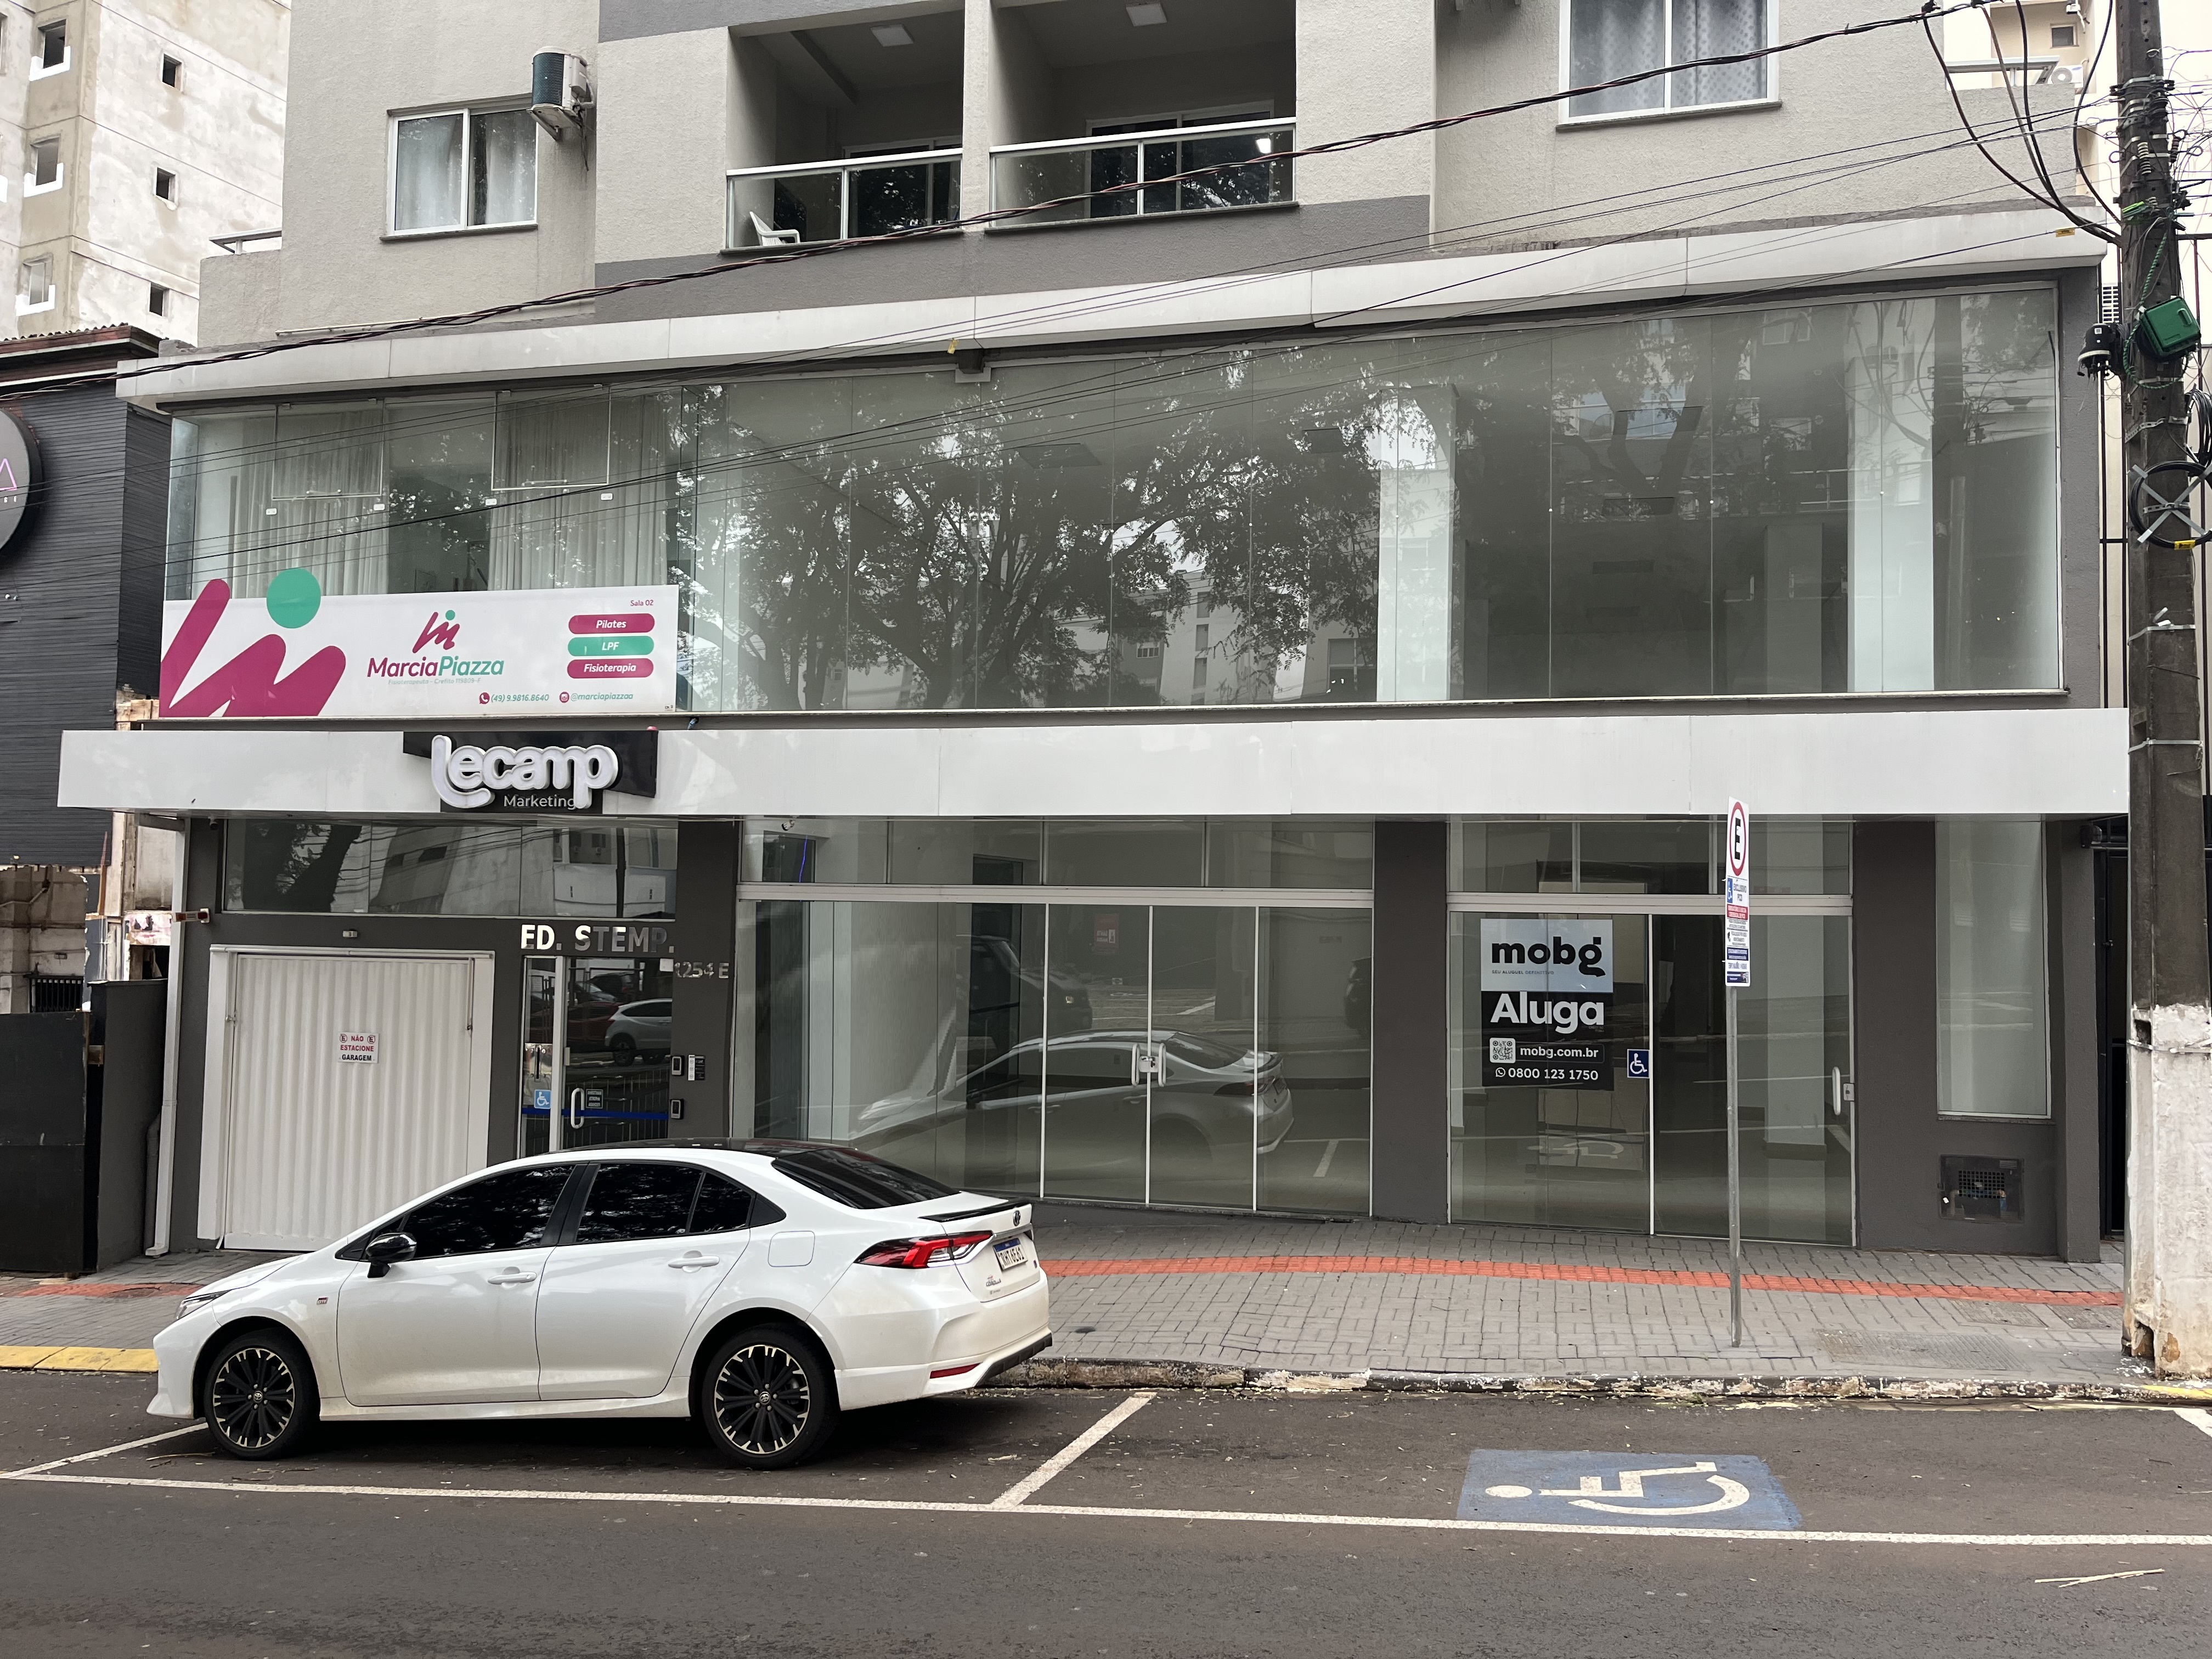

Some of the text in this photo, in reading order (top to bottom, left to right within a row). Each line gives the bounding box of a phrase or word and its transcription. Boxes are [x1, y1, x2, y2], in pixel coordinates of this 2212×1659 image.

[596, 619, 627, 629] Pilates
[602, 642, 619, 651] LPF
[584, 663, 636, 674] Fisioterapia
[491, 694, 505, 702] (49)
[571, 692, 634, 702] @marciapiazzaa
[504, 794, 576, 810] Marketing
[521, 924, 562, 950] ED.
[1492, 936, 1606, 977] mobg
[674, 962, 729, 979] 1254 E
[1490, 991, 1604, 1034] Aluga
[1520, 1046, 1599, 1059] mobg.com.br
[1508, 1068, 1599, 1080] 0800 123 1750
